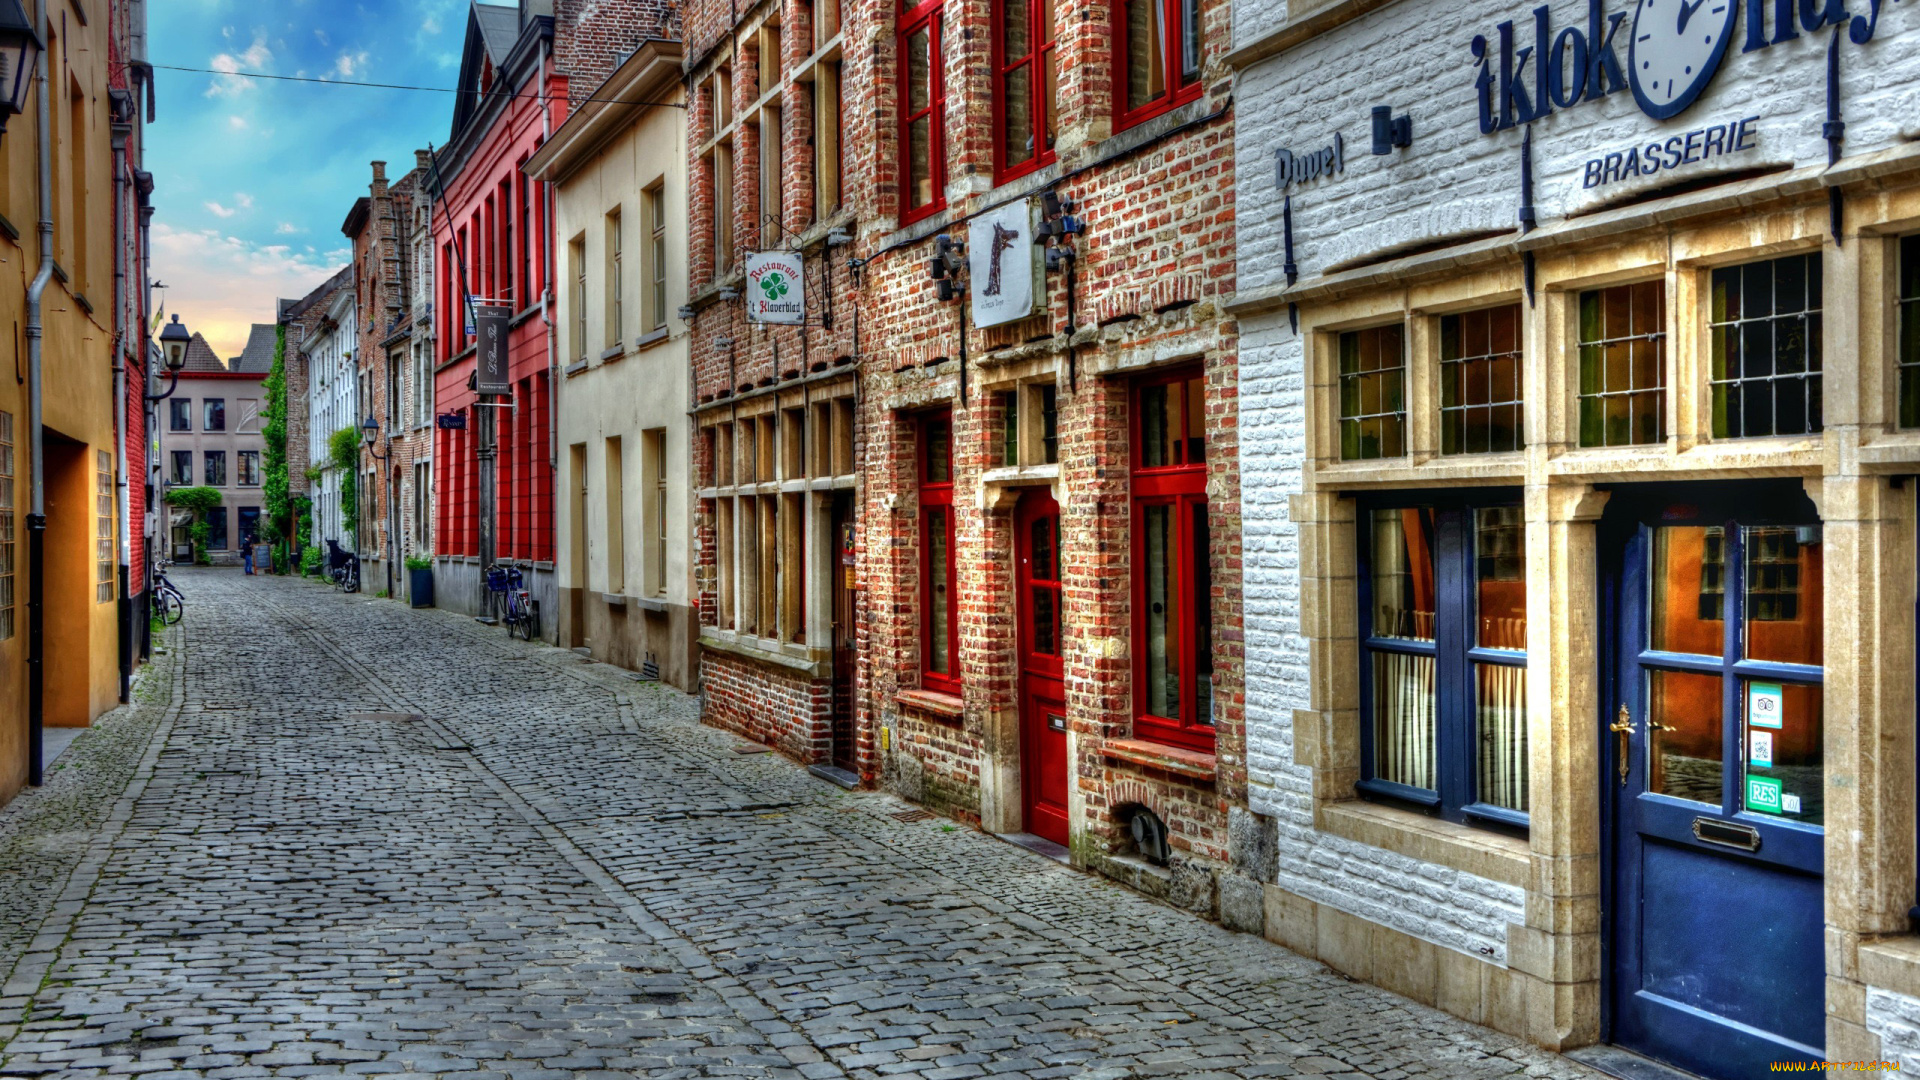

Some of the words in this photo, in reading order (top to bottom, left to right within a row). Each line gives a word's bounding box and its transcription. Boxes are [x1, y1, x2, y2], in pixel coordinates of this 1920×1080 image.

[1274, 131, 1343, 190] Duvel
[1582, 115, 1760, 189] BRASSERIE
[749, 261, 799, 282] Restaurant
[759, 300, 801, 314] Klaverblad
[1752, 784, 1776, 804] RES
